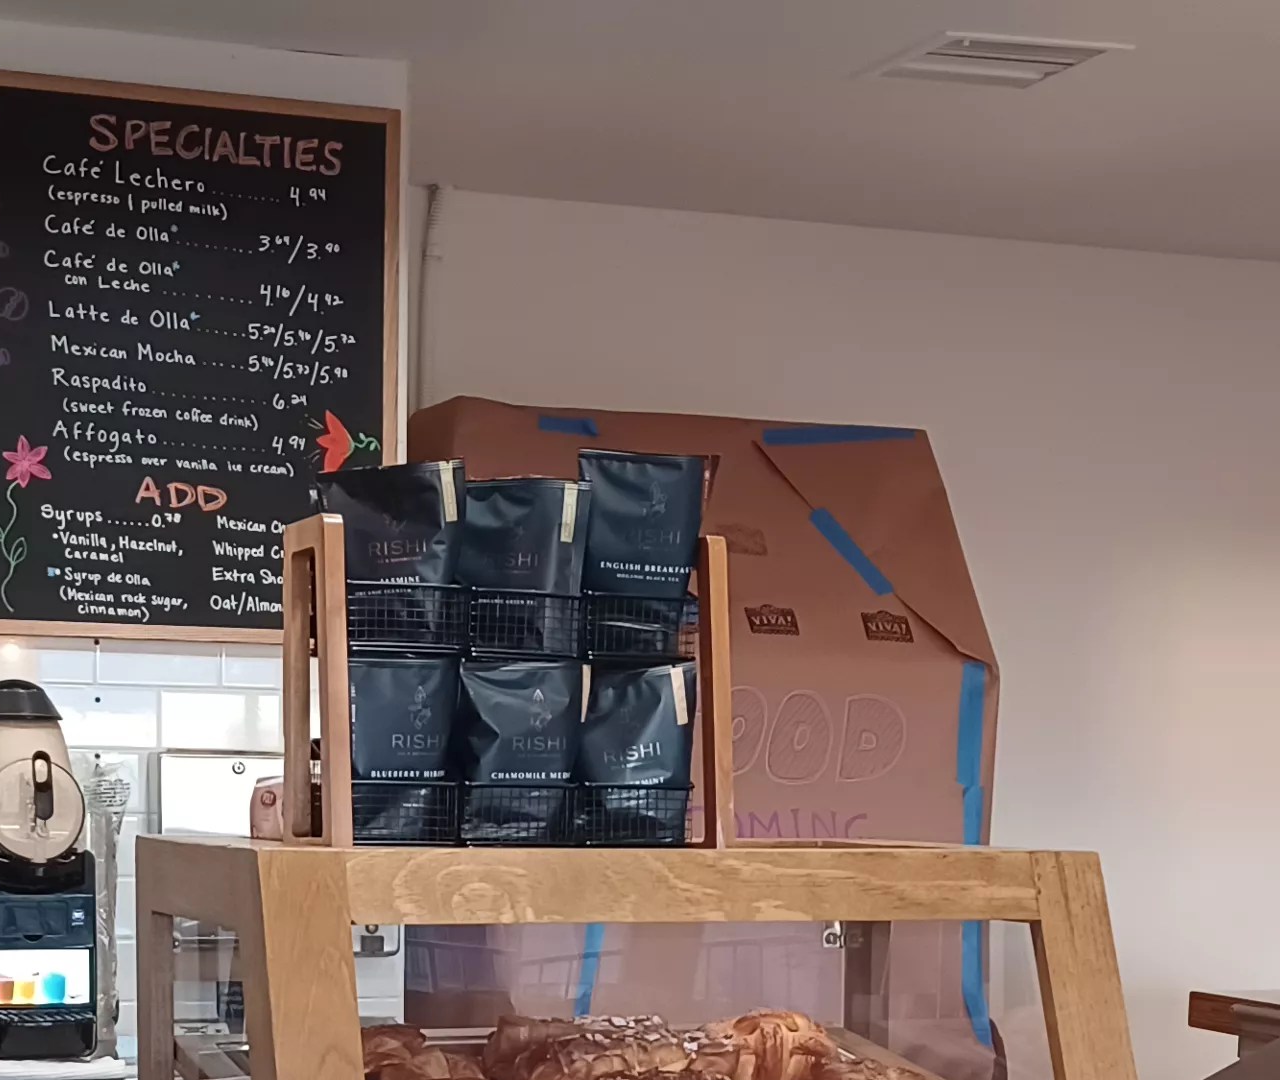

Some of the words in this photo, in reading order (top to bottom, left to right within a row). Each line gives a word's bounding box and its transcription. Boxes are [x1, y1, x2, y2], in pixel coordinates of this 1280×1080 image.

[89, 114, 343, 175] SPECIALTIES
[43, 155, 103, 178] Café
[116, 161, 204, 192] Lechero
[49, 185, 119, 205] (espresso
[142, 199, 182, 213] pulled
[189, 203, 227, 220] milk)
[45, 215, 94, 234] Café
[106, 223, 125, 237] de
[44, 250, 95, 268] Café
[107, 258, 128, 272] de
[65, 274, 87, 285] con
[98, 276, 150, 292] Leche
[49, 301, 109, 322] Latte
[121, 310, 138, 325] de
[51, 335, 126, 359] Mexican
[138, 343, 195, 365] Mocha
[52, 368, 146, 393] Raspadito
[63, 398, 114, 413] (sweet
[122, 401, 167, 418] frozen
[176, 408, 212, 422] coffee
[220, 414, 258, 431] drink)
[53, 420, 156, 452] Affogato
[64, 446, 132, 468] (espresso
[142, 457, 167, 466] over
[176, 459, 217, 470] vanilla
[250, 463, 294, 477] cream)
[136, 476, 227, 511] ADD
[41, 504, 102, 529] Syrups
[217, 515, 266, 532] Mexican
[65, 548, 123, 563] Caramel
[119, 536, 182, 556] Hazelnut,
[212, 541, 264, 561] Whipped
[368, 538, 427, 557] RISHI
[212, 567, 255, 583] Extra
[600, 560, 641, 571] ENGLISH
[65, 567, 101, 586] Syrup
[107, 573, 122, 583] de
[125, 574, 150, 586] Olla
[60, 586, 114, 602] (Mexican
[121, 593, 146, 603] rock
[151, 595, 187, 611] sugar,
[78, 603, 149, 622] cinnamon)
[749, 614, 793, 627] VIVA!
[866, 620, 907, 635] VIVA!
[512, 736, 566, 751] RISHI
[603, 741, 661, 764] RISHI
[370, 770, 420, 778] BLUEBERRY
[491, 771, 546, 780] CHAMOMILE
